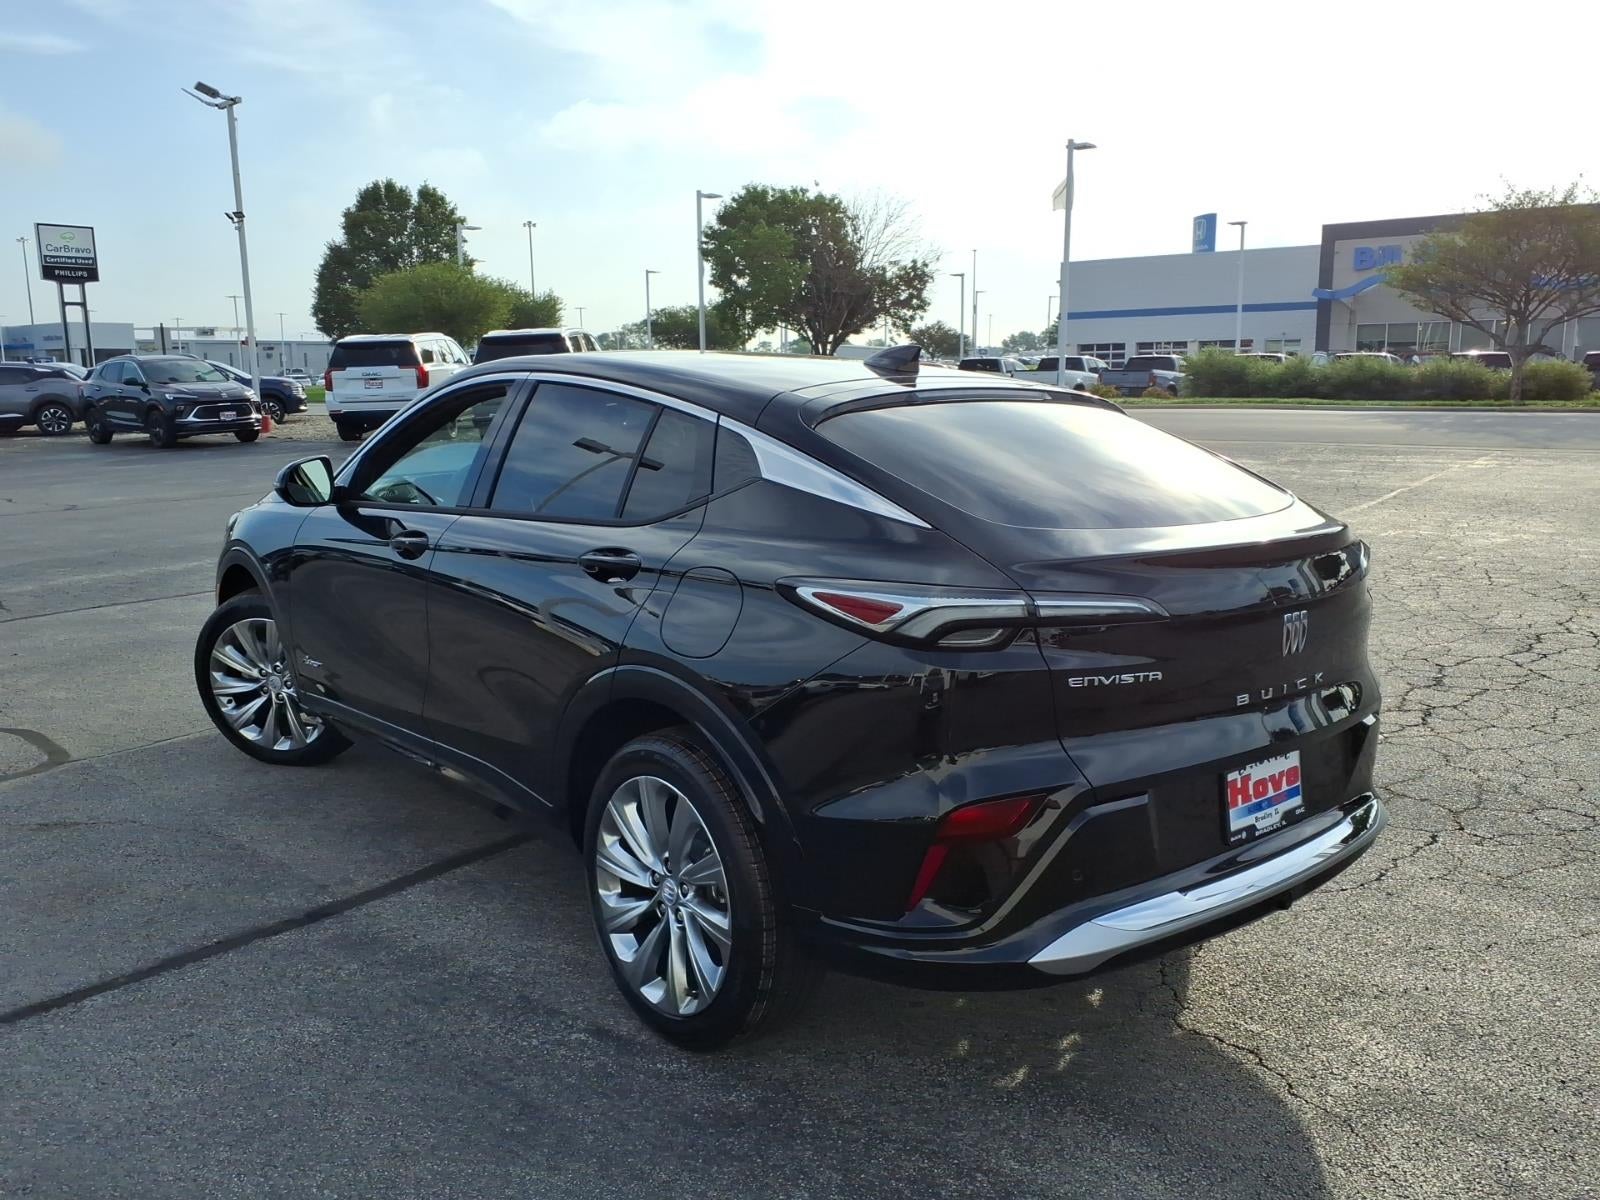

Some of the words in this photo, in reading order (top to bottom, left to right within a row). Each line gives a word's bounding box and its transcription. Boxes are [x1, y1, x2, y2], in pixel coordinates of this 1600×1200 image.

[45, 243, 92, 254] CarBravo
[1068, 671, 1163, 688] ENVISTA
[1236, 672, 1325, 707] BUICK
[1227, 765, 1300, 808] Hove
